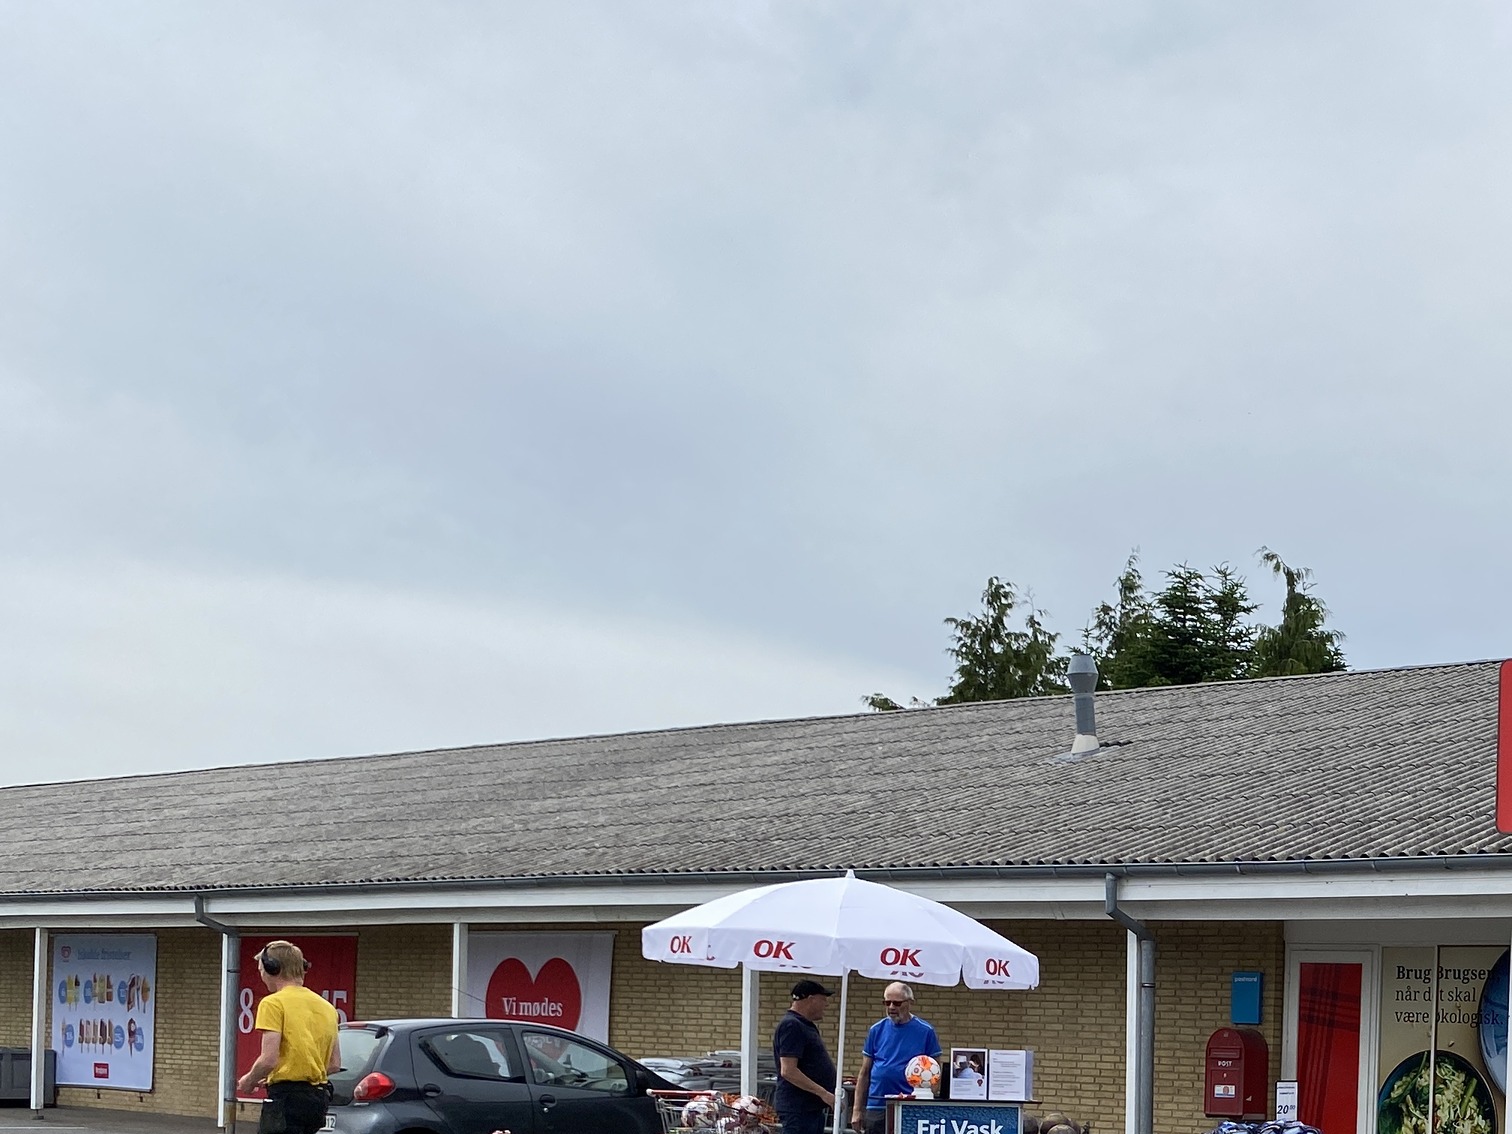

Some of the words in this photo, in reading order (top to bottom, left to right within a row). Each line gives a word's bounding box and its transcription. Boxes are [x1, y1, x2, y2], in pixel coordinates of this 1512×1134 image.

[670, 936, 692, 954] OK
[753, 939, 796, 960] OK
[880, 947, 924, 967] OK
[985, 958, 1011, 977] OK
[1396, 965, 1432, 984] Brug
[1395, 985, 1420, 1002] når
[1423, 987, 1444, 1002] dt
[1447, 987, 1476, 1002] skal
[502, 997, 516, 1016] Vi
[520, 998, 563, 1017] mødes
[1395, 1011, 1430, 1023] være
[1277, 1104, 1289, 1114] 20
